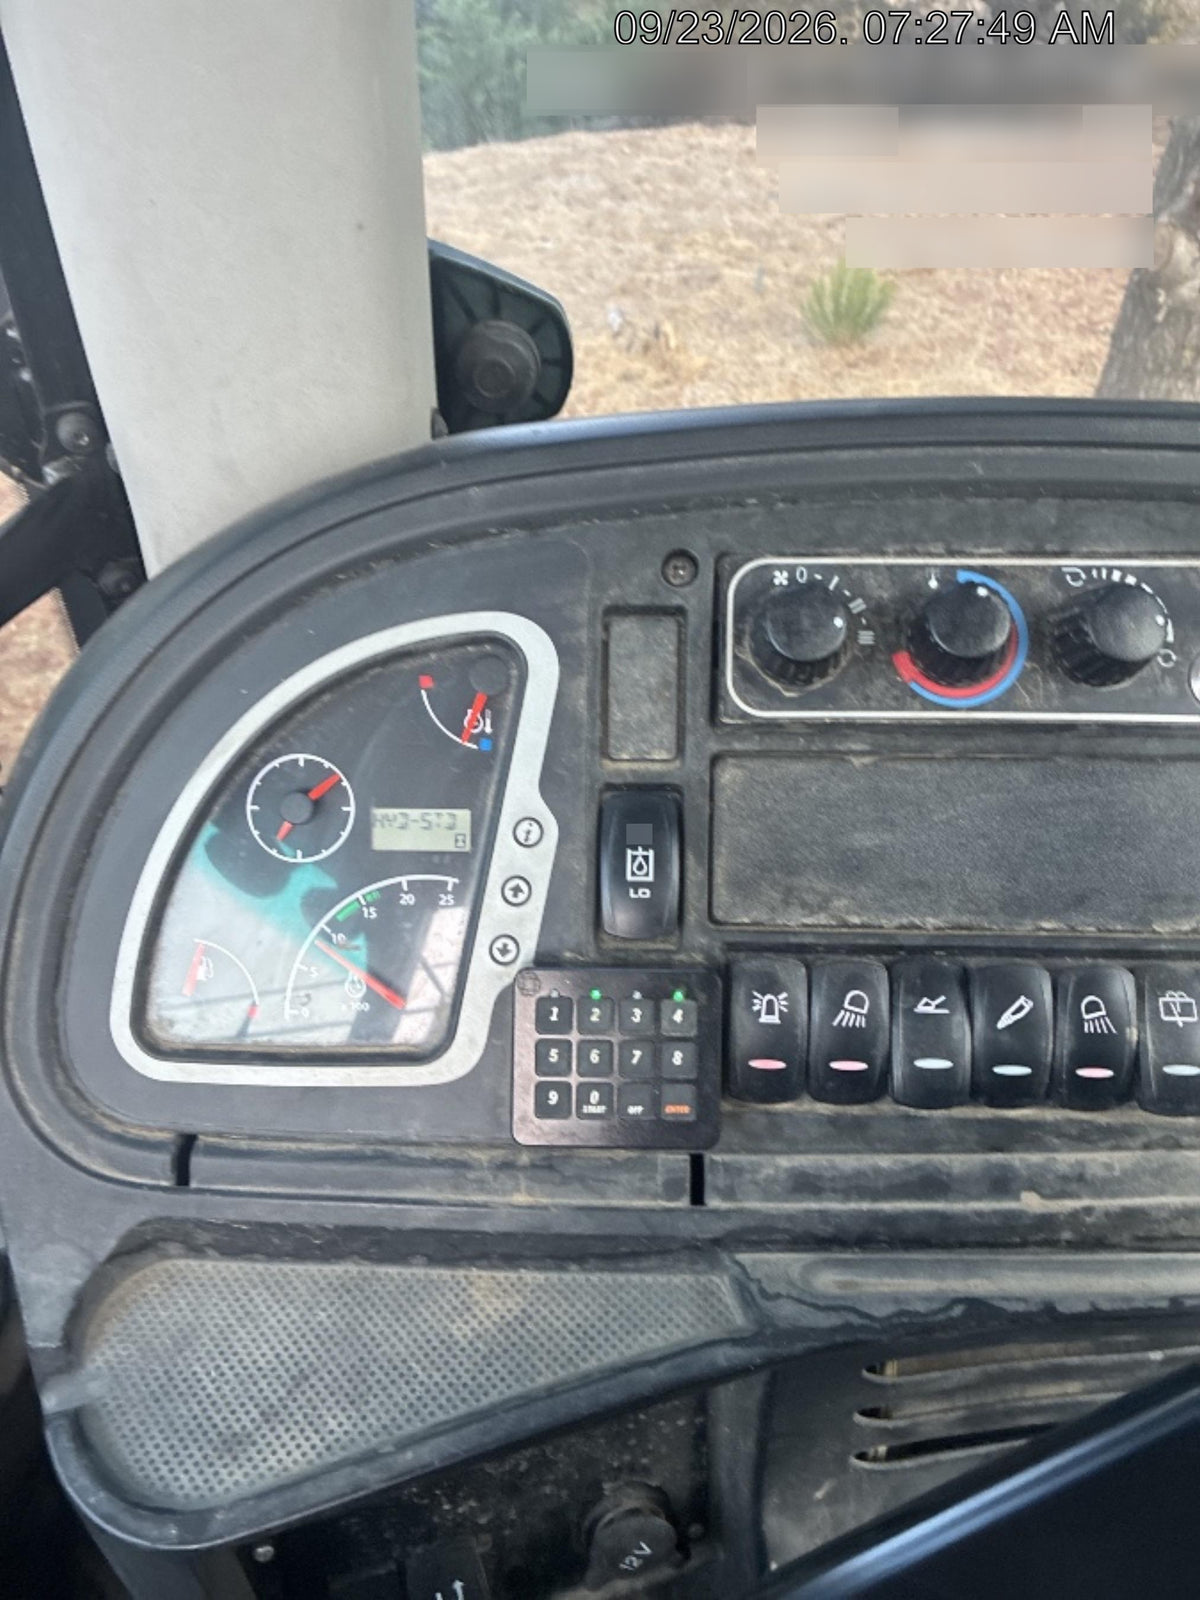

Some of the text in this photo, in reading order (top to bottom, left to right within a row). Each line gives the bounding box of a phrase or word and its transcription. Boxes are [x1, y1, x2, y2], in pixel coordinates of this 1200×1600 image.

[399, 893, 416, 906] 20
[438, 894, 455, 906] 25
[362, 907, 378, 919] 15
[331, 933, 347, 944] 10
[309, 966, 319, 979] 5
[549, 1006, 559, 1022] 1
[590, 1008, 601, 1022] 2
[630, 1008, 642, 1022] 3
[672, 1009, 684, 1023] 4
[548, 1049, 559, 1063] 5
[589, 1049, 600, 1064] 6
[631, 1050, 642, 1064] 7
[671, 1051, 684, 1066] 8
[547, 1091, 559, 1105] 9
[589, 1091, 600, 1105] 0
[618, 1540, 653, 1571] 12V
